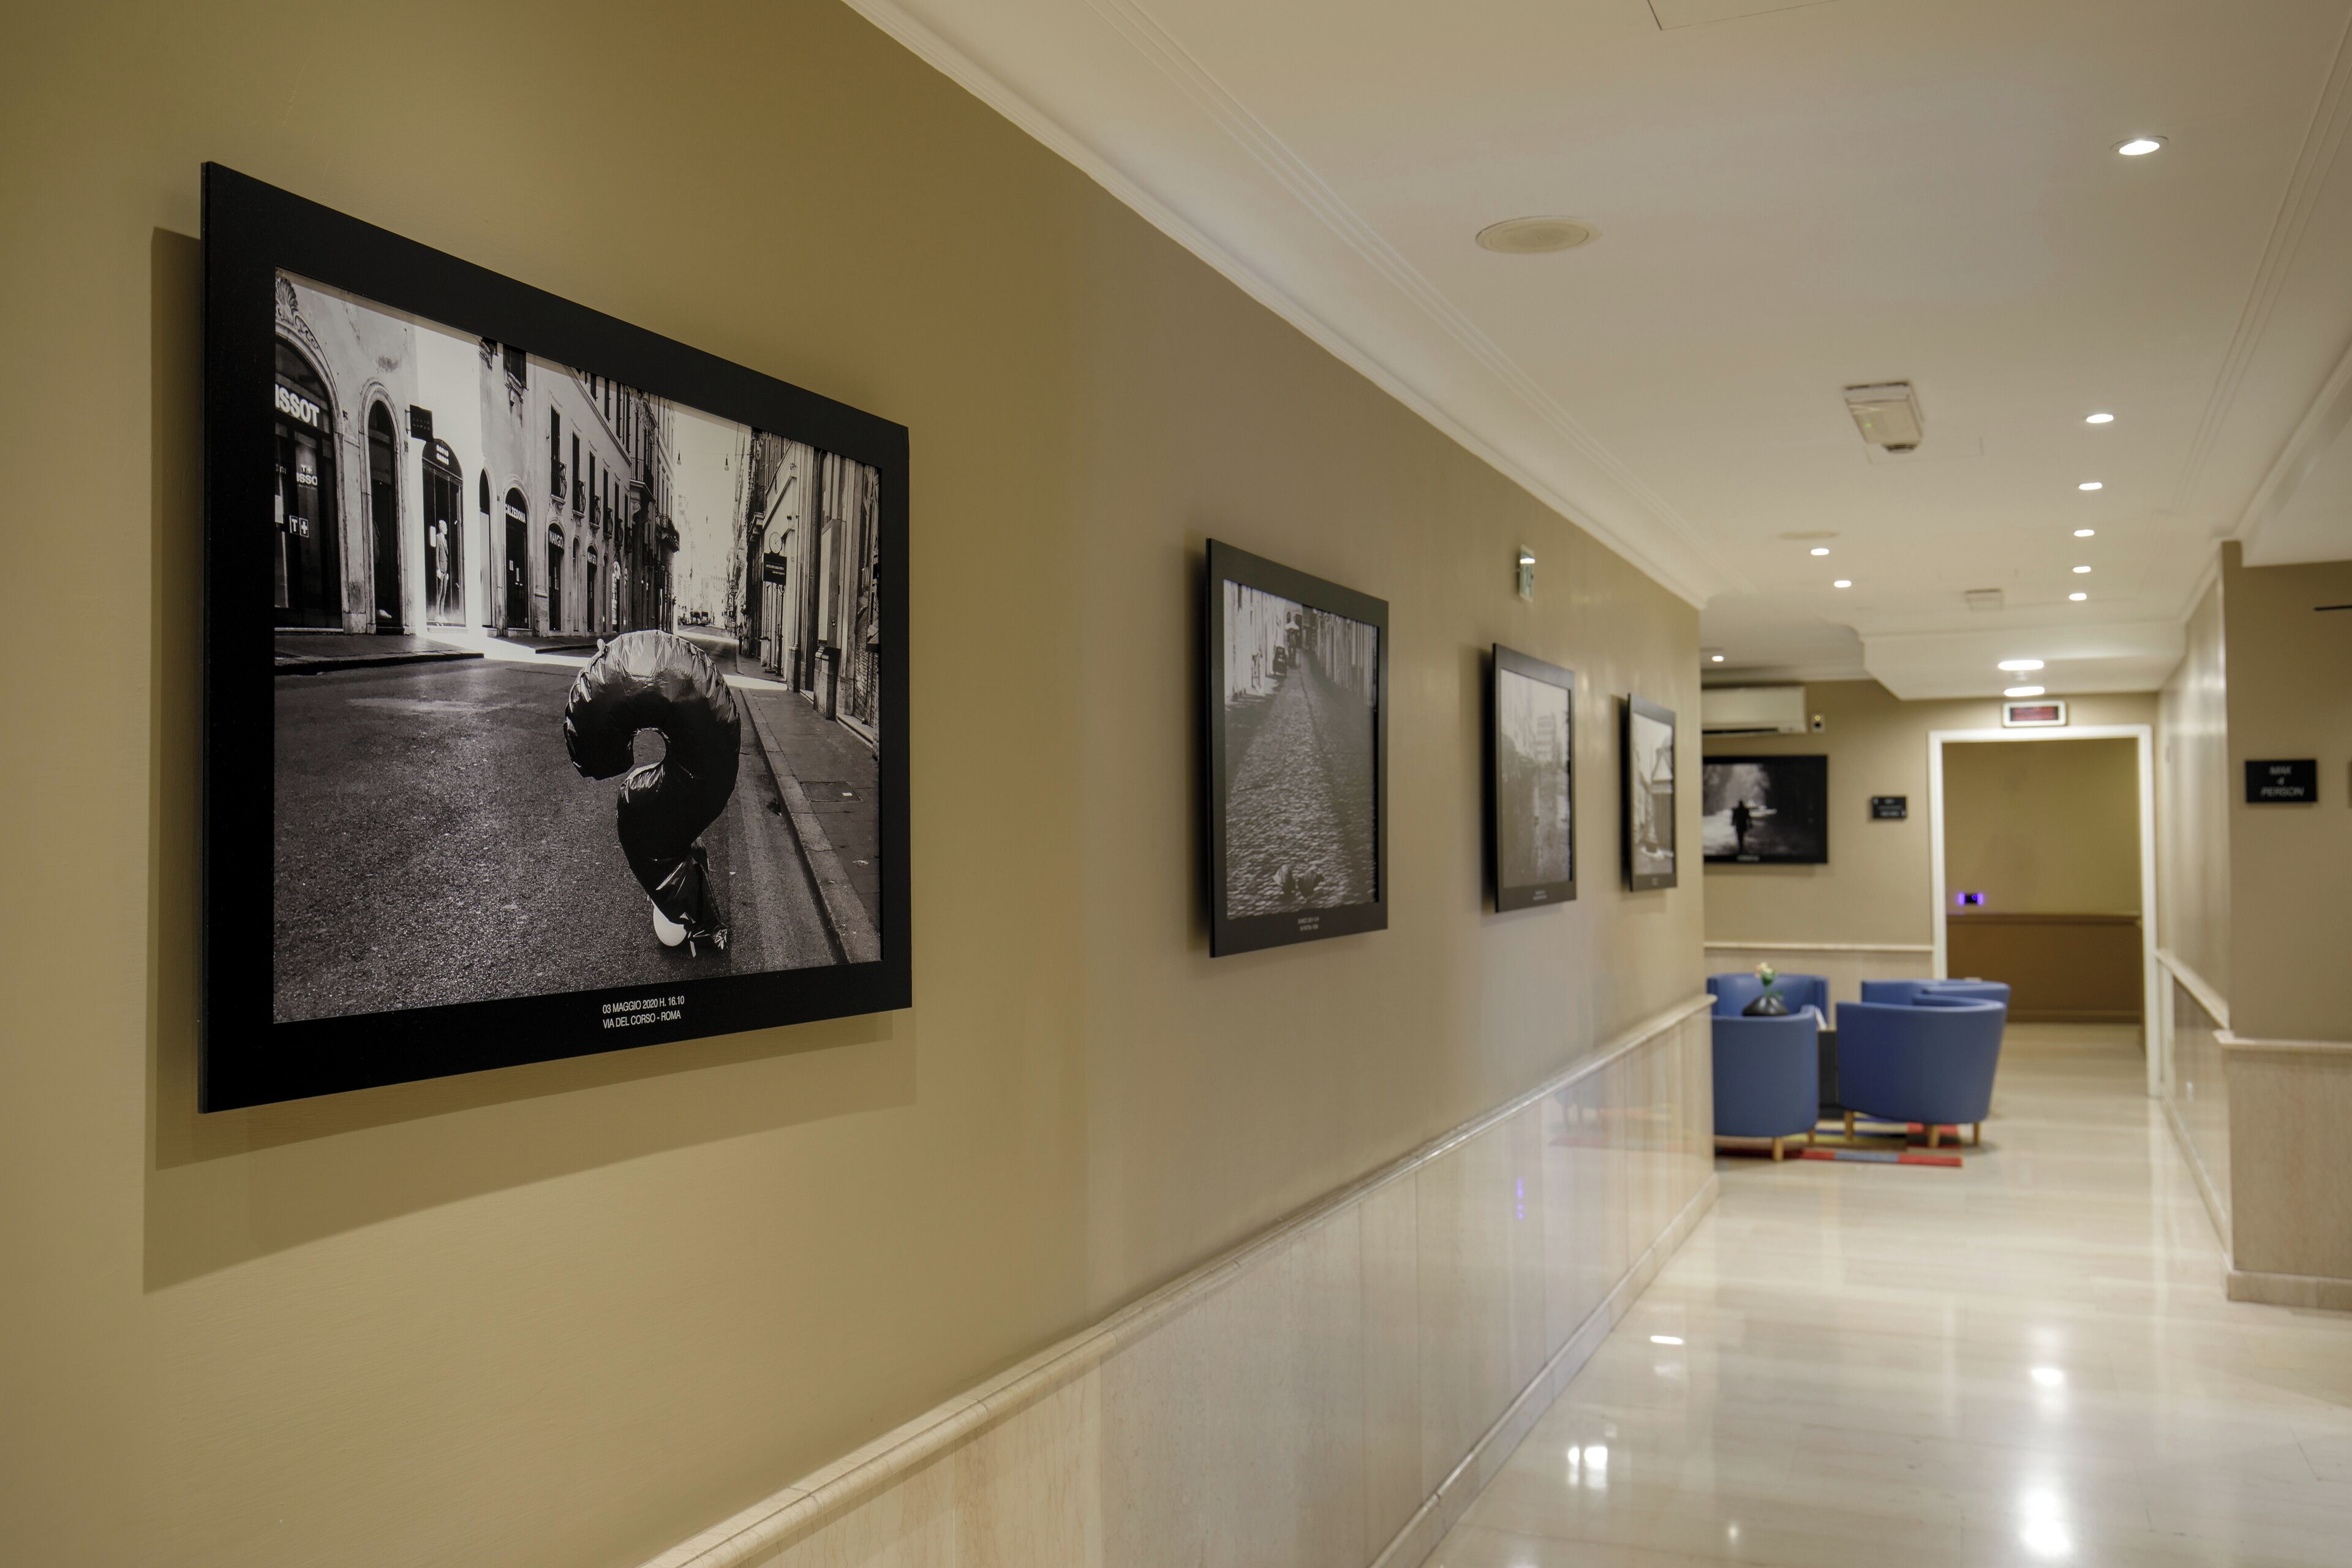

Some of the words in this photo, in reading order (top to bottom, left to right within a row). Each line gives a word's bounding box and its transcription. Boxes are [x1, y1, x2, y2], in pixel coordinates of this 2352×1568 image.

[549, 530, 564, 549] MANGO
[603, 1004, 611, 1014] 03
[612, 1000, 641, 1012] MAGGIO
[643, 998, 658, 1009] 2020
[659, 997, 666, 1007] H.
[668, 995, 685, 1006] 16.10
[603, 1018, 614, 1029] VIA
[616, 1017, 630, 1027] DEL
[630, 1012, 656, 1025] CORSO
[661, 1009, 681, 1022] ROMA
